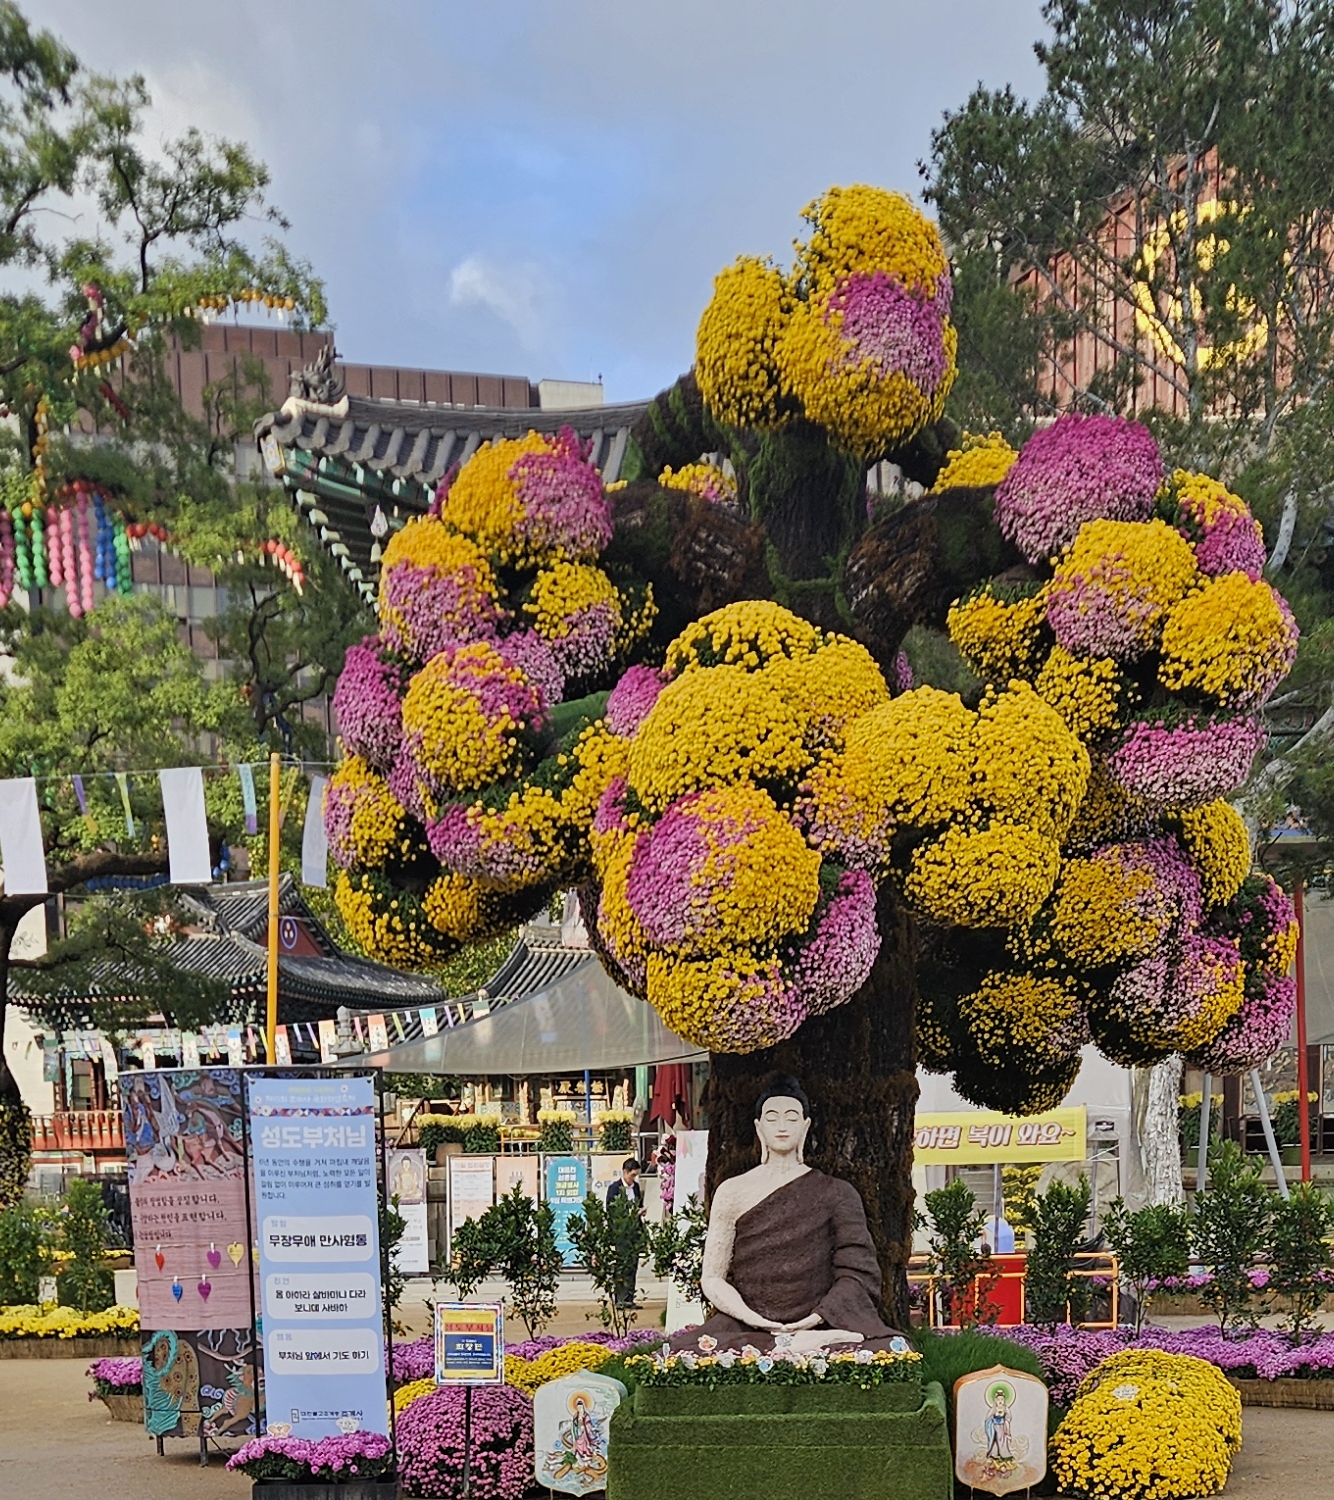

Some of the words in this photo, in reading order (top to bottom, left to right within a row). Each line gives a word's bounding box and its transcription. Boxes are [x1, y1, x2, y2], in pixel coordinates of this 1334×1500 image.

[260, 1124, 366, 1148] 성도부처님
[914, 1126, 961, 1149] 하면
[968, 1124, 1012, 1147] 복이
[269, 1235, 316, 1247] 무장무애
[349, 1289, 366, 1298] 다라
[279, 1351, 303, 1360] 부처님
[333, 1351, 349, 1360] 기도
[352, 1351, 369, 1360] 하기
